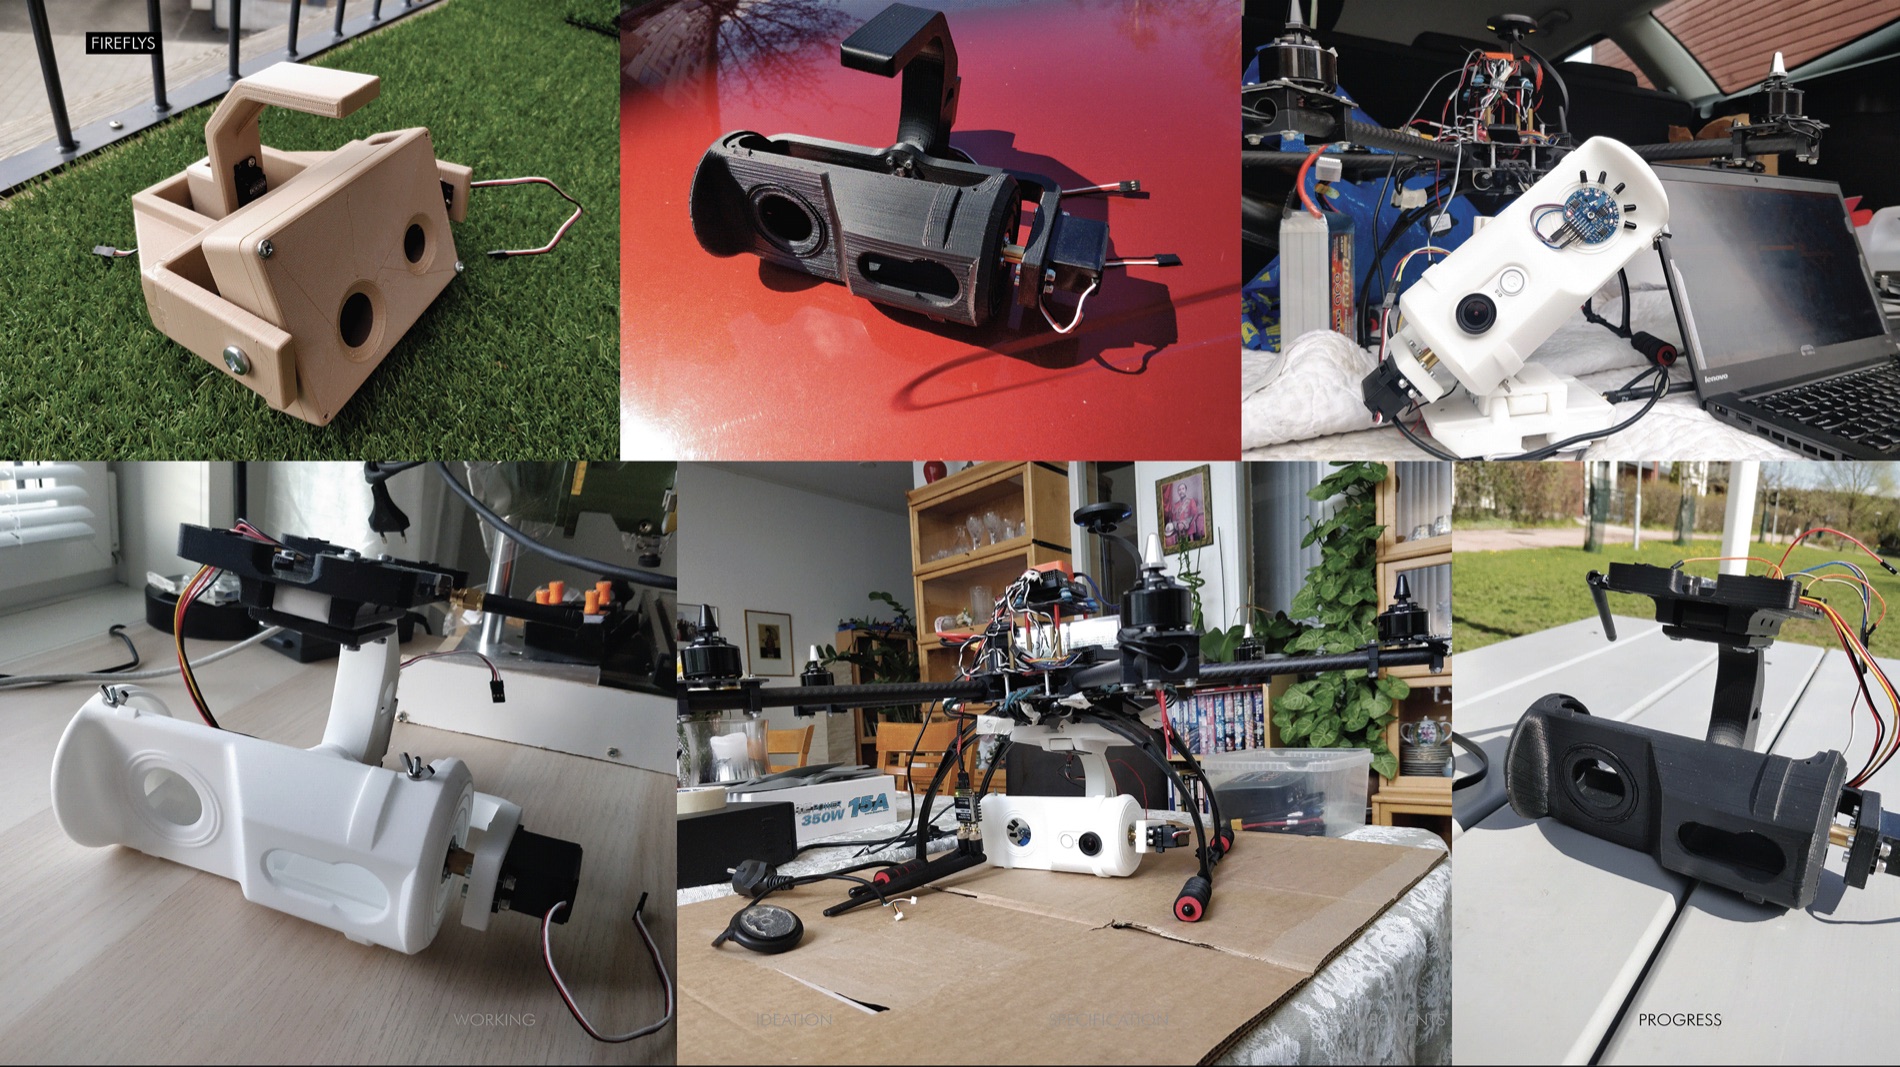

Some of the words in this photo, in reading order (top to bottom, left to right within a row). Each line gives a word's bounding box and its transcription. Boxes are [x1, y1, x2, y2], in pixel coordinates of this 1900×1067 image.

[1704, 373, 1729, 384] lenovo
[847, 792, 890, 819] 15A
[801, 808, 846, 827] 350W
